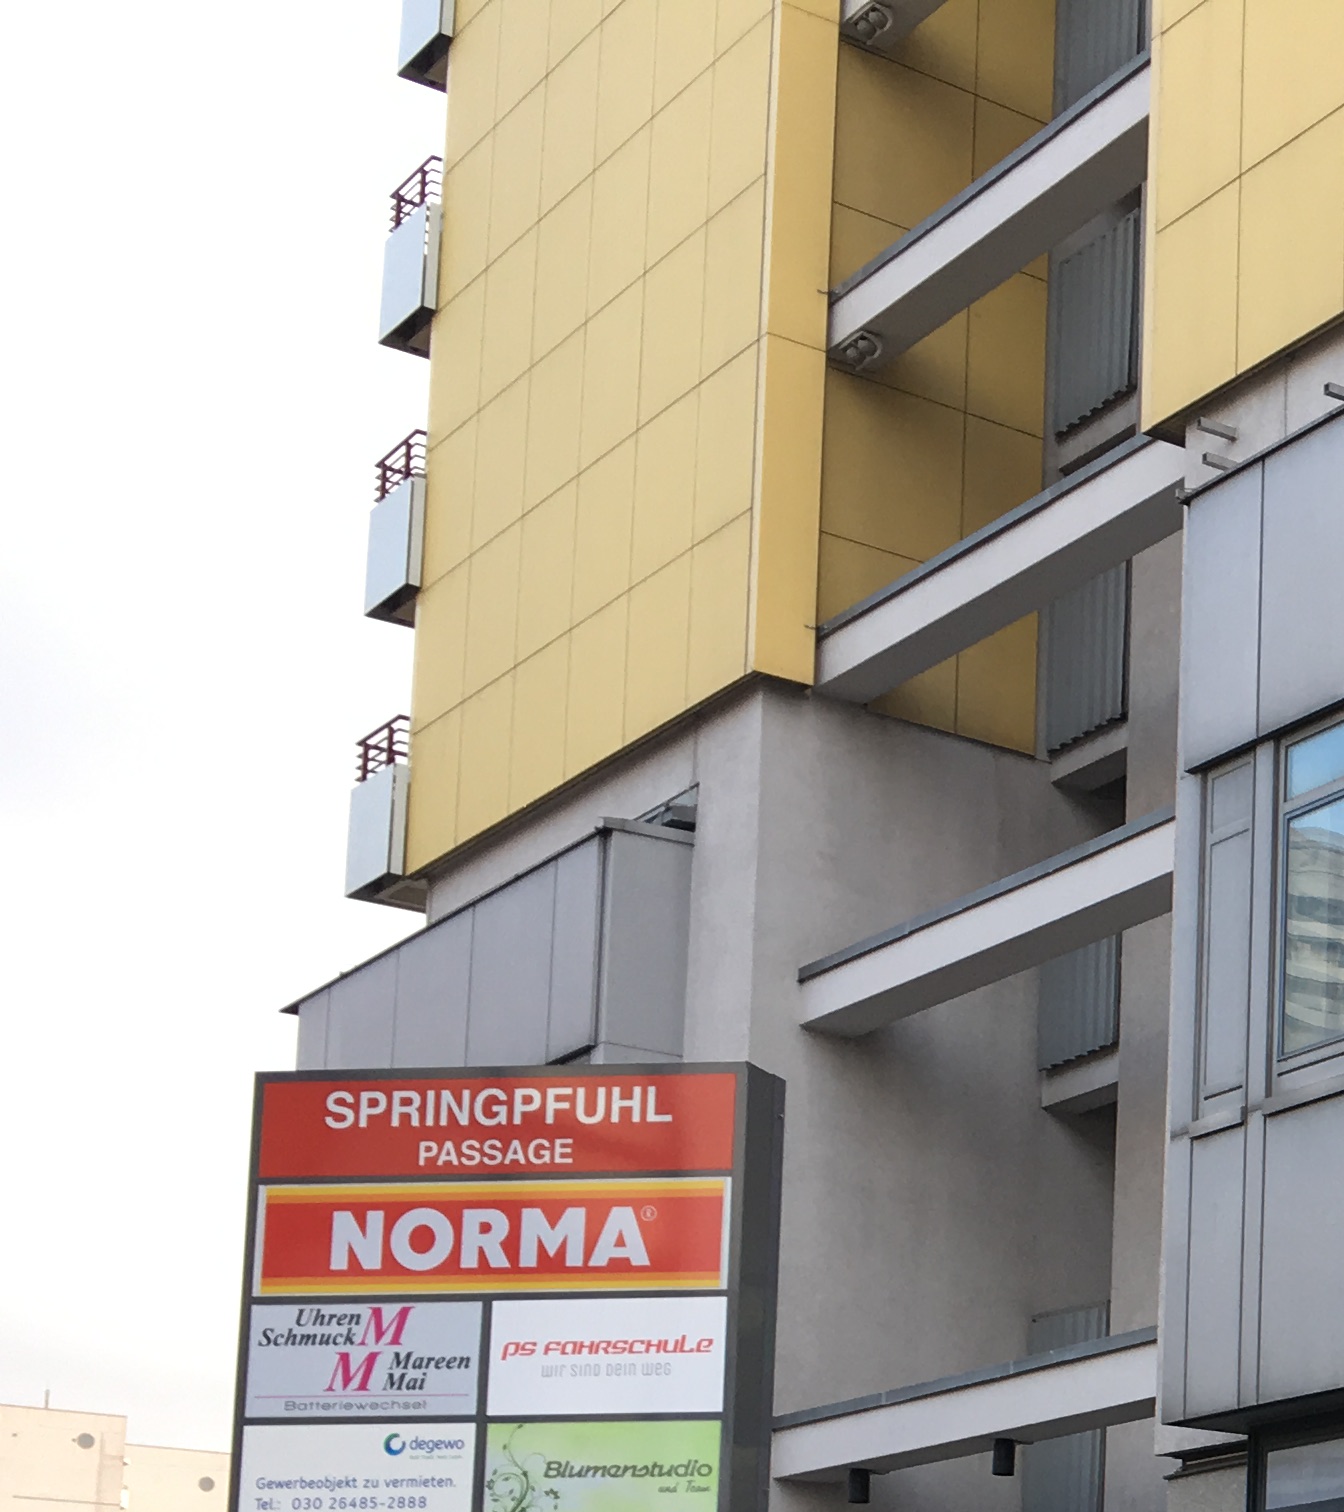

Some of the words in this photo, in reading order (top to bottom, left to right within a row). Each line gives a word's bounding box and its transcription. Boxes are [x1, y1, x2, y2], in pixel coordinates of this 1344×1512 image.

[323, 1086, 674, 1129] SPRINGPFUHL
[417, 1138, 574, 1166] PASSAGE
[329, 1205, 651, 1271] NORMA
[258, 1327, 358, 1347] Schmuck
[356, 1306, 416, 1346] M
[295, 1308, 362, 1327] Uhren
[323, 1351, 383, 1392] M
[389, 1351, 472, 1371] Mareen
[382, 1372, 428, 1392] Mai
[284, 1399, 428, 1412] Batteriewechsel
[409, 1435, 465, 1454] degewo
[543, 1459, 713, 1479] Blumenstudio
[255, 1476, 358, 1493] Gewerbeobjekt
[362, 1478, 379, 1489] zu
[384, 1475, 457, 1489] vermieten.
[291, 1497, 323, 1511] 030
[329, 1495, 428, 1510] 26485-2888
